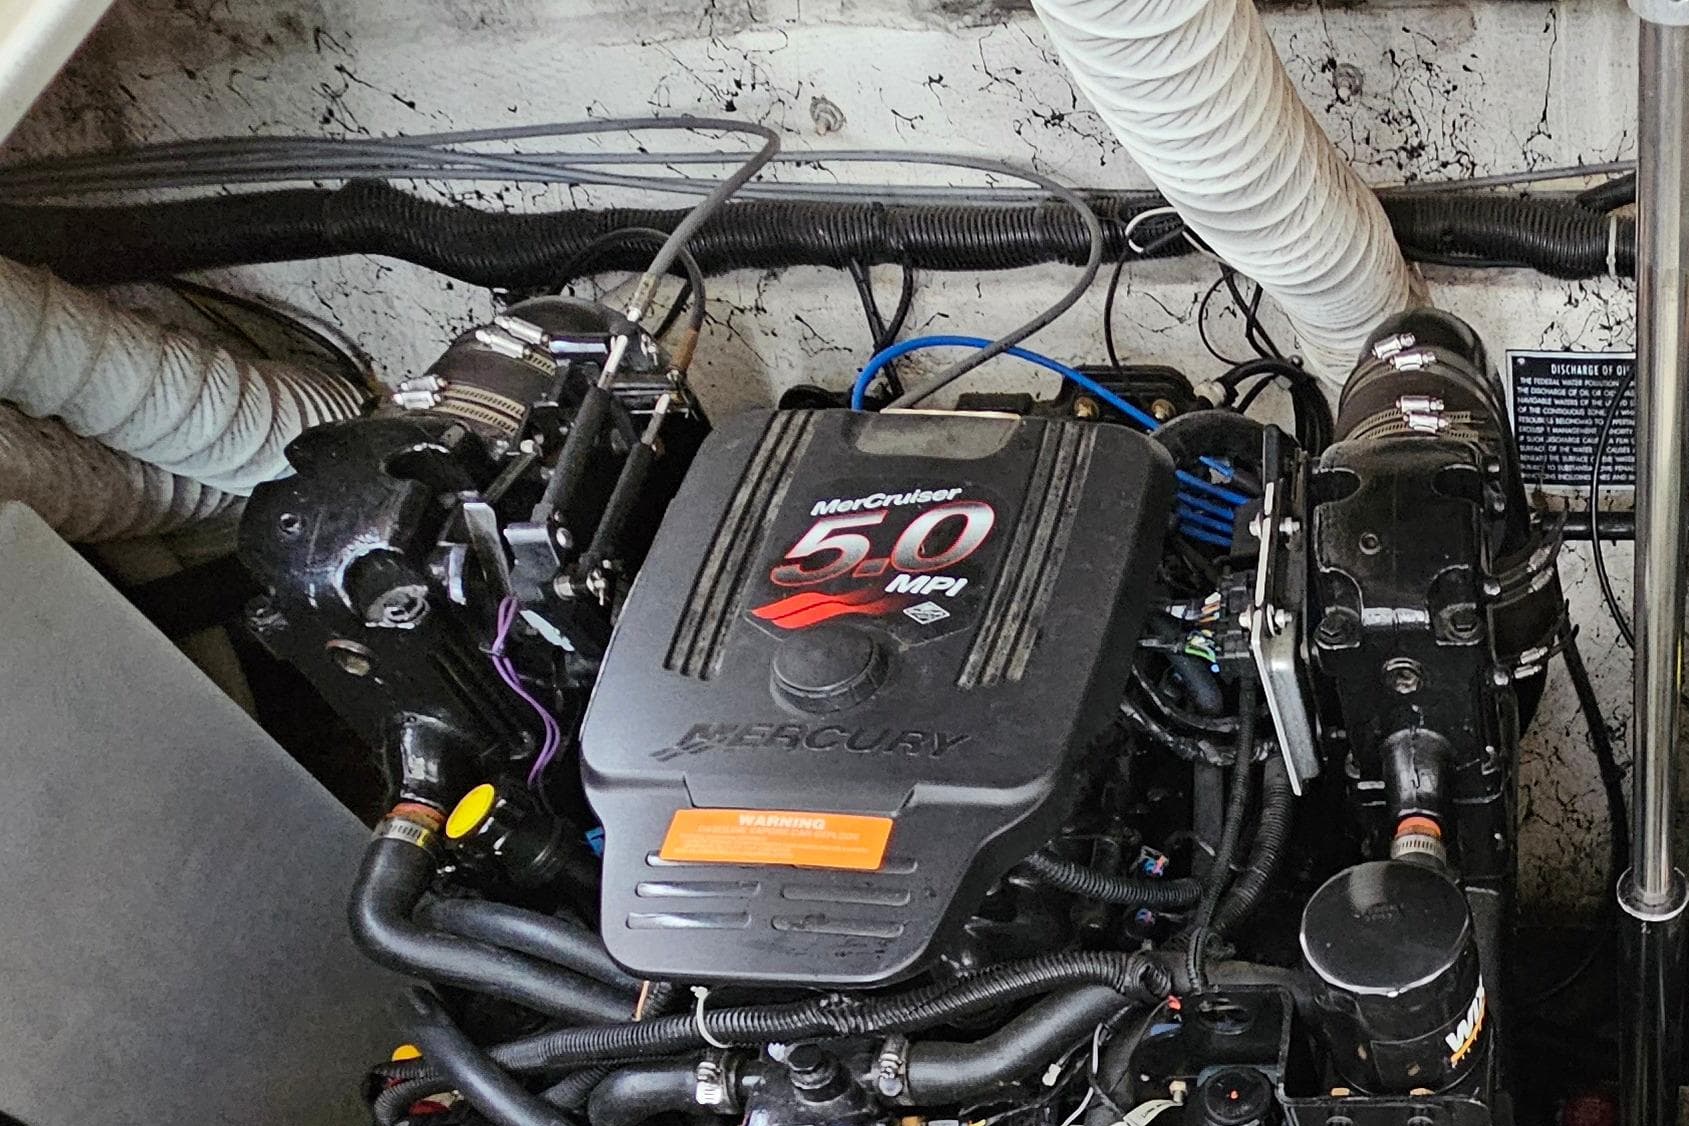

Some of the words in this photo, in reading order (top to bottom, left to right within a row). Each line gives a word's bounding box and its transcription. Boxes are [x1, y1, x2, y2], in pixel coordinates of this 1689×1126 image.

[1533, 378, 1560, 386] FEDERAL
[1551, 364, 1599, 375] DISCHARGE
[1602, 365, 1612, 375] OF
[810, 487, 963, 516] MerCruiser
[769, 500, 996, 588] 5.0
[884, 573, 969, 598] MPI
[649, 722, 972, 761] MERCURY
[738, 814, 826, 830] WARNING
